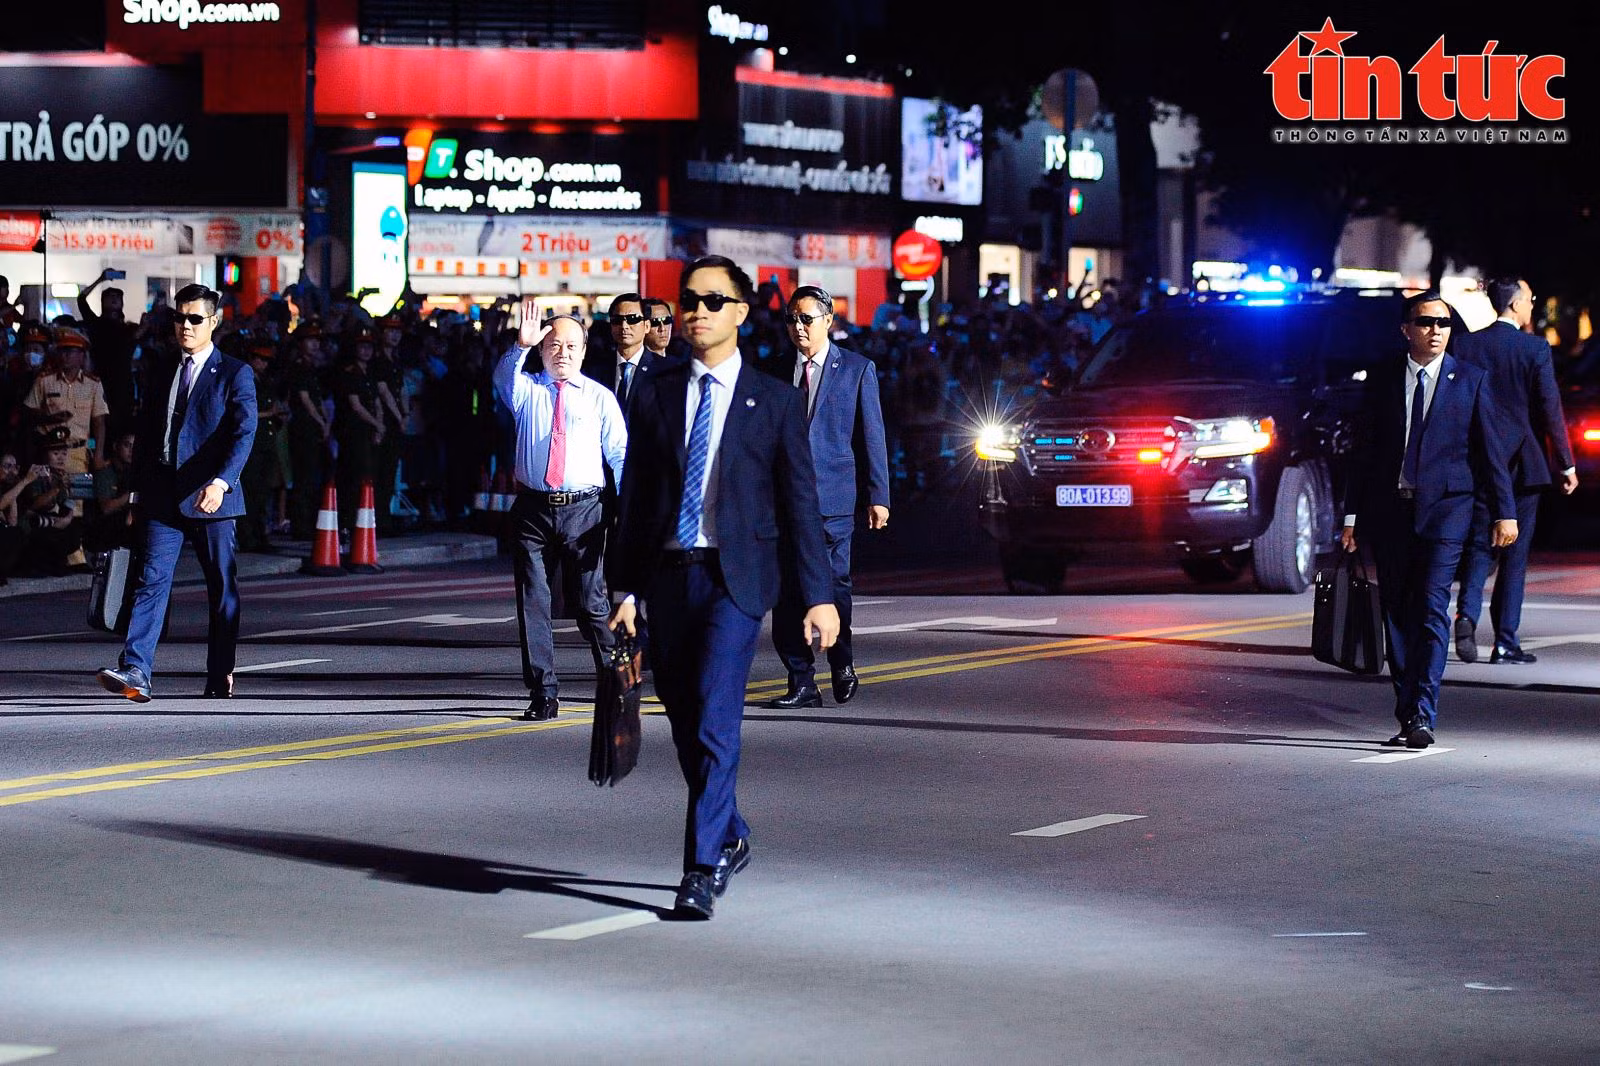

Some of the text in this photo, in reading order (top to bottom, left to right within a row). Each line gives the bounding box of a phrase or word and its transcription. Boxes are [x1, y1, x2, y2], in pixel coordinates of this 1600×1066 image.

[0, 110, 190, 162] TRẢ GÓP 0%
